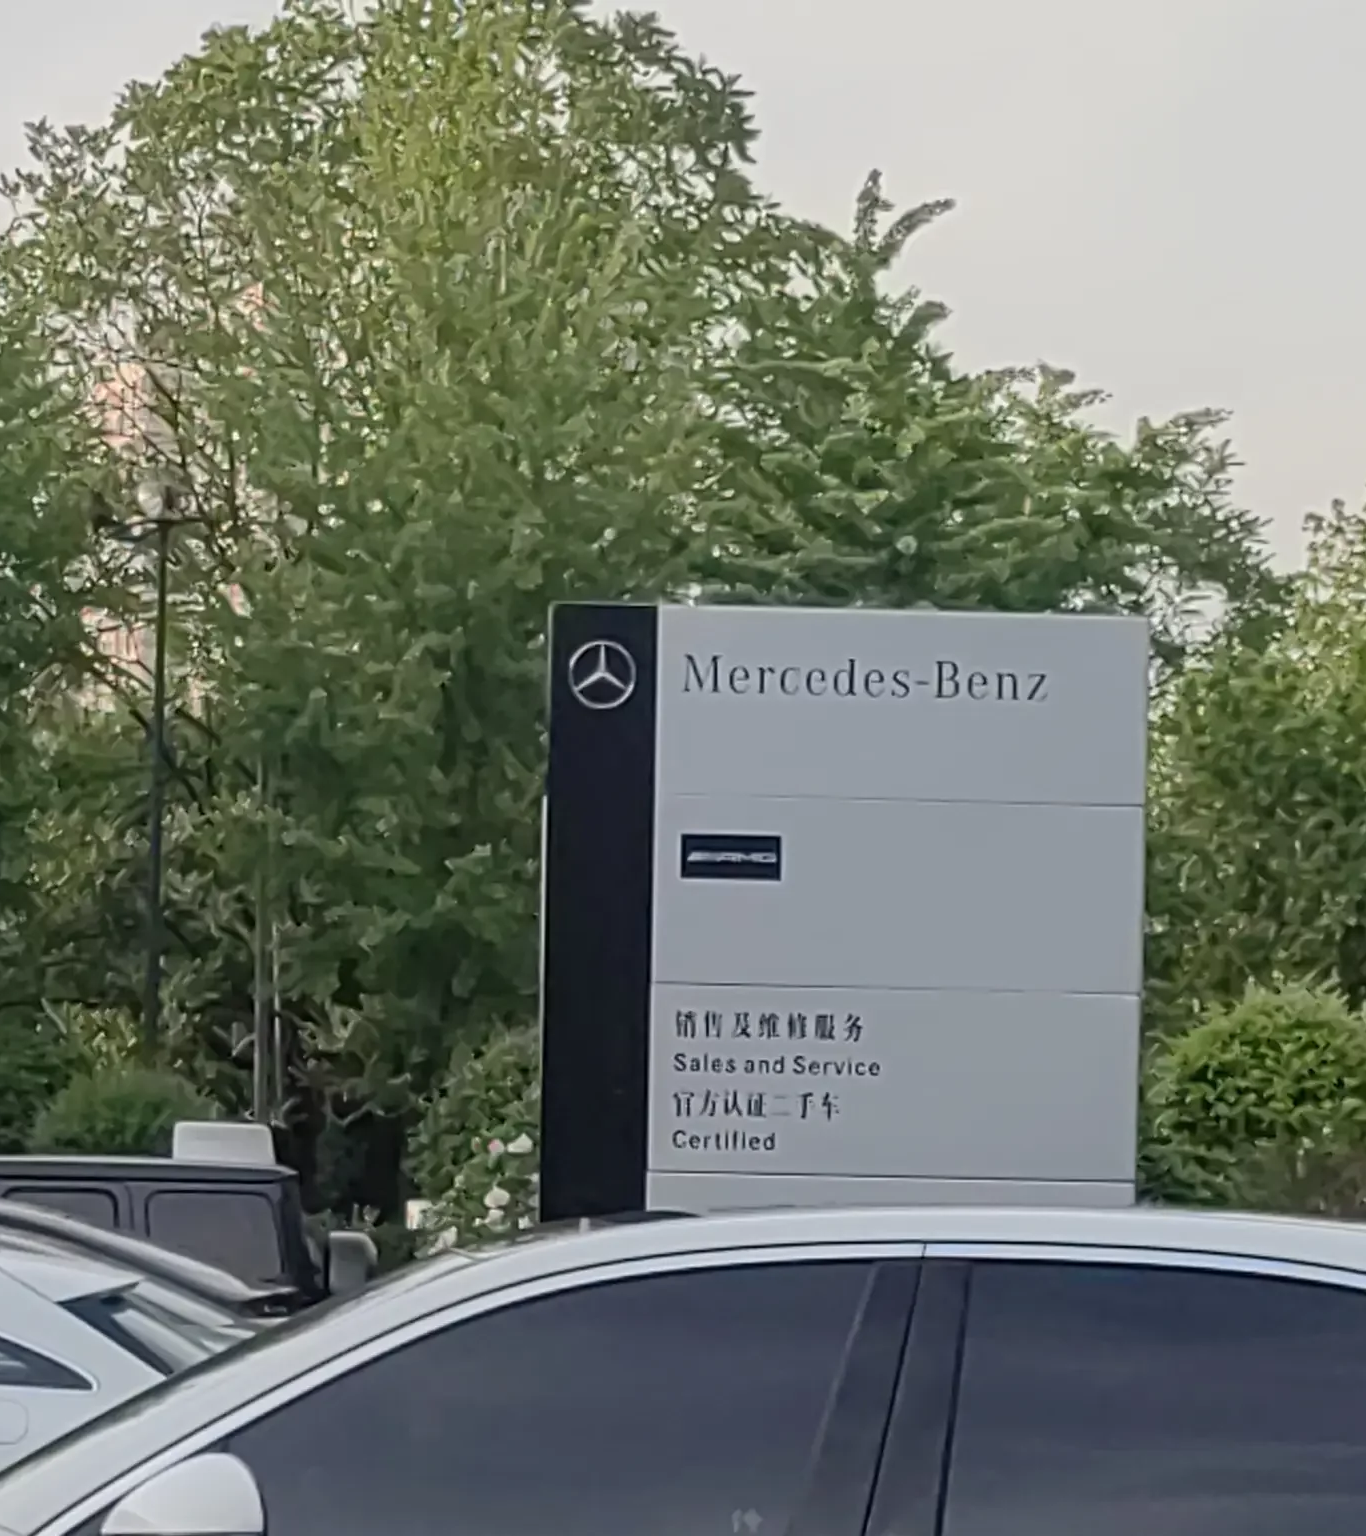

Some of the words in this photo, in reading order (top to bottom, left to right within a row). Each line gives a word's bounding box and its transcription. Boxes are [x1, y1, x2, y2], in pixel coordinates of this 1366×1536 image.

[683, 652, 1049, 702] Mercedes-Benz
[675, 1009, 864, 1042] 销售及维修服务
[673, 1052, 737, 1074] Sales
[743, 1055, 785, 1075] and
[792, 1055, 881, 1077] Service
[672, 1088, 840, 1122] 官方认证二手车
[671, 1129, 776, 1151] Certified
